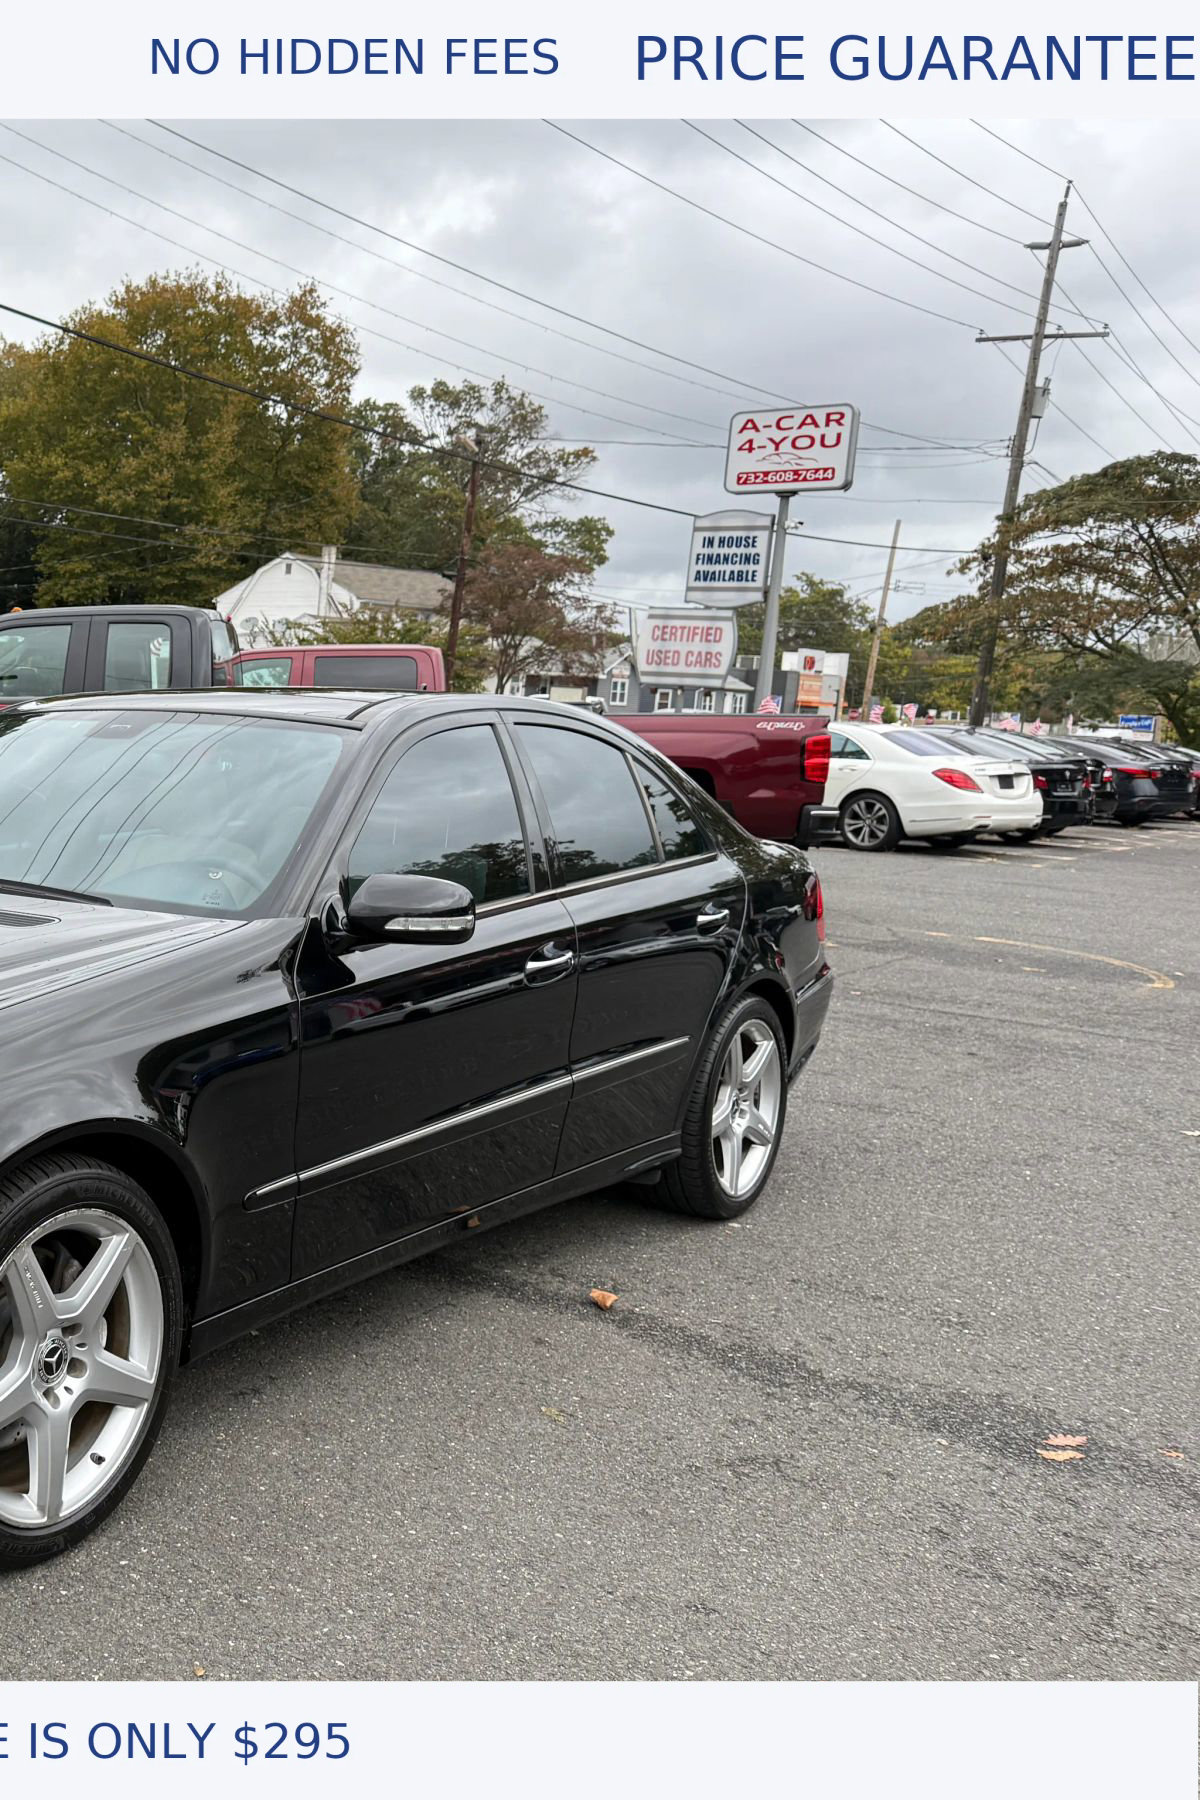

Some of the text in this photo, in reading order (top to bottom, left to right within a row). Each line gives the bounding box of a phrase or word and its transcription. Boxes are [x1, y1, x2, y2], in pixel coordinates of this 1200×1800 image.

[738, 411, 845, 434] A-CAR
[737, 432, 842, 453] 4-YOU
[738, 468, 833, 484] 732-608-7644
[702, 536, 758, 548] IN HOUSE
[695, 553, 761, 566] FINANCING
[694, 570, 758, 582] AVAILABLE
[651, 625, 723, 643] CERTIFIED
[646, 649, 722, 668] USED CARS
